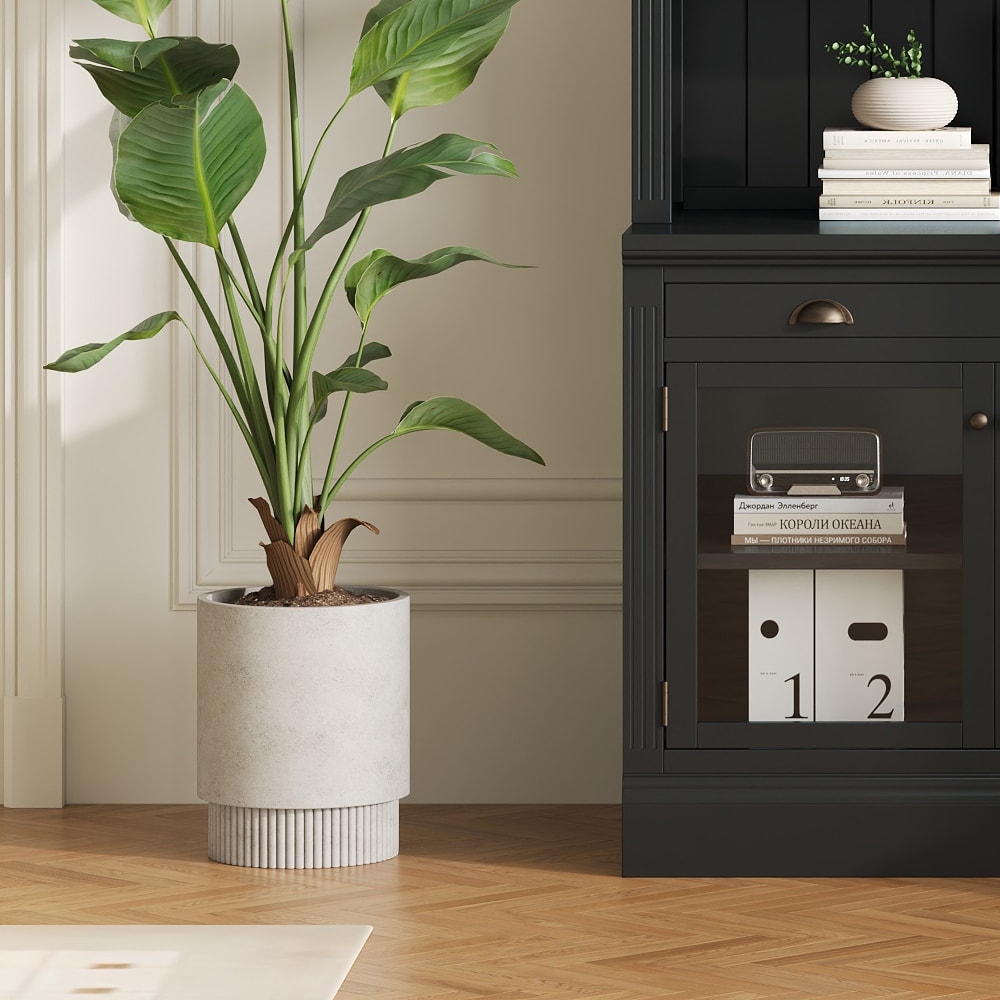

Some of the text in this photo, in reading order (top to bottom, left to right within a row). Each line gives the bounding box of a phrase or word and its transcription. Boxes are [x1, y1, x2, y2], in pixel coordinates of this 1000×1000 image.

[738, 502, 818, 510] Джордан Элленберг
[779, 518, 882, 530] КОРОЛИ ОКЕАНА
[744, 536, 758, 544] МЫ
[771, 536, 812, 544] ПЛОТНИКИ
[814, 536, 860, 544] НЕЗРИМОГО
[861, 536, 892, 544] СОБОРА
[784, 672, 809, 719] 1
[866, 673, 895, 719] 2
